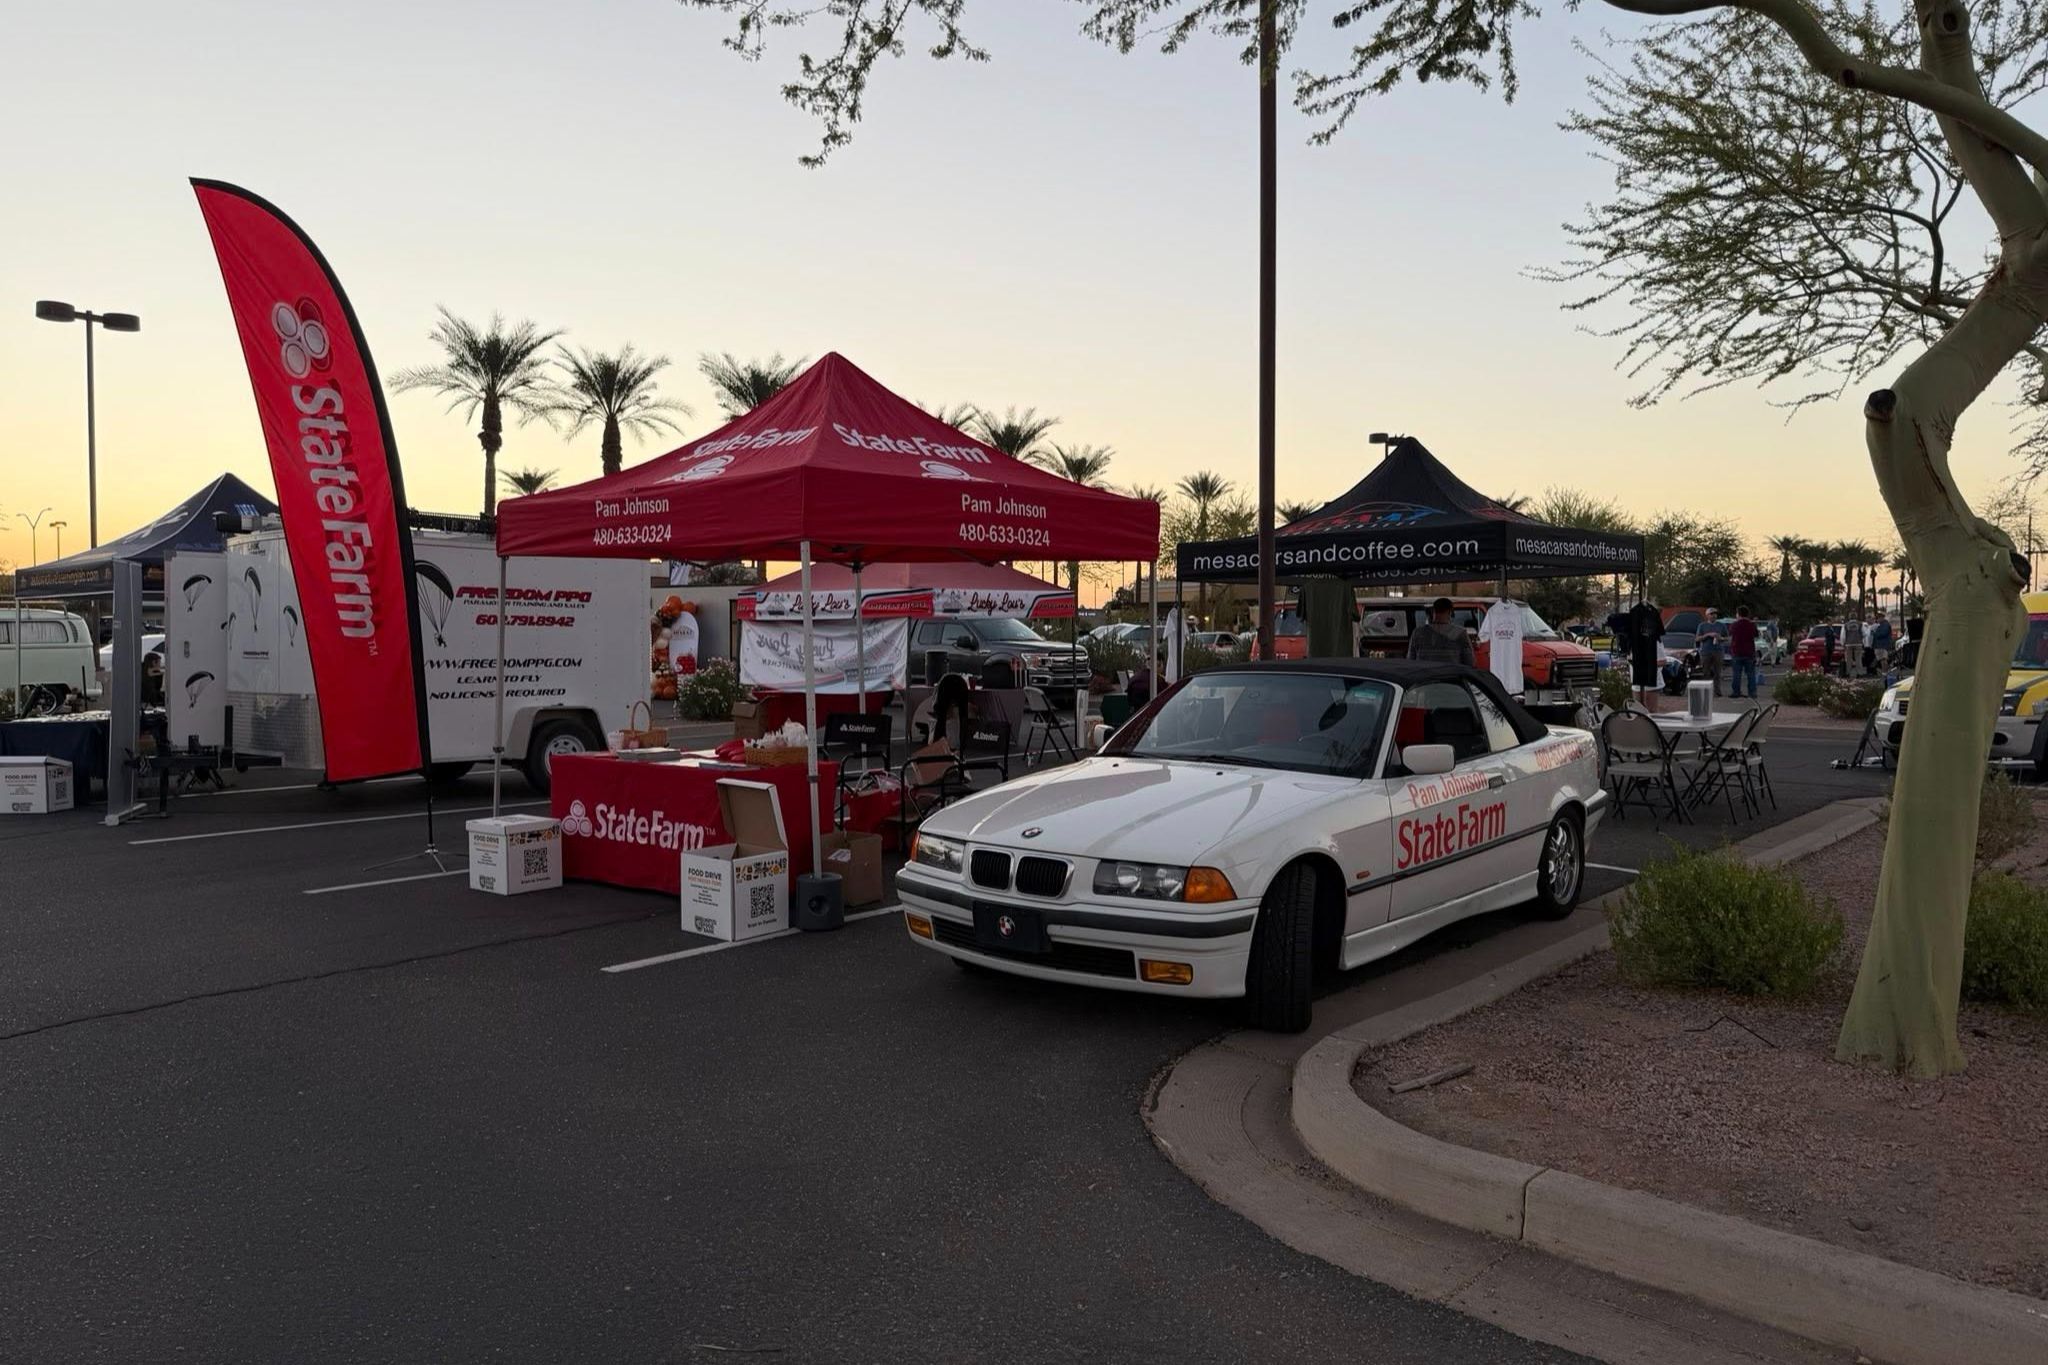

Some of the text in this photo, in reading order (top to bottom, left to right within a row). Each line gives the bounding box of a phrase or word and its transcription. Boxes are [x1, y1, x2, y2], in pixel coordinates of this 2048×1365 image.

[595, 497, 670, 518] Pam Johnson
[961, 493, 1047, 519] Pam Johnson
[593, 523, 672, 546] 480-633-0324
[959, 524, 1050, 547] 480-633-0324
[1193, 536, 1479, 571] mesacrsandcoffee.com
[1515, 536, 1638, 563] mesacarsandcoffee.com
[789, 593, 851, 617] Luy Lou's
[968, 593, 1025, 616] Lucky Lou's
[425, 658, 582, 669] WW.FREEOMPPG.COM
[457, 675, 542, 684] LEARN TO FLY
[429, 689, 566, 700] NO LICENS REQUIRED
[1408, 770, 1488, 808] Pam Johnson
[688, 867, 722, 880] FOOD DRIVE
